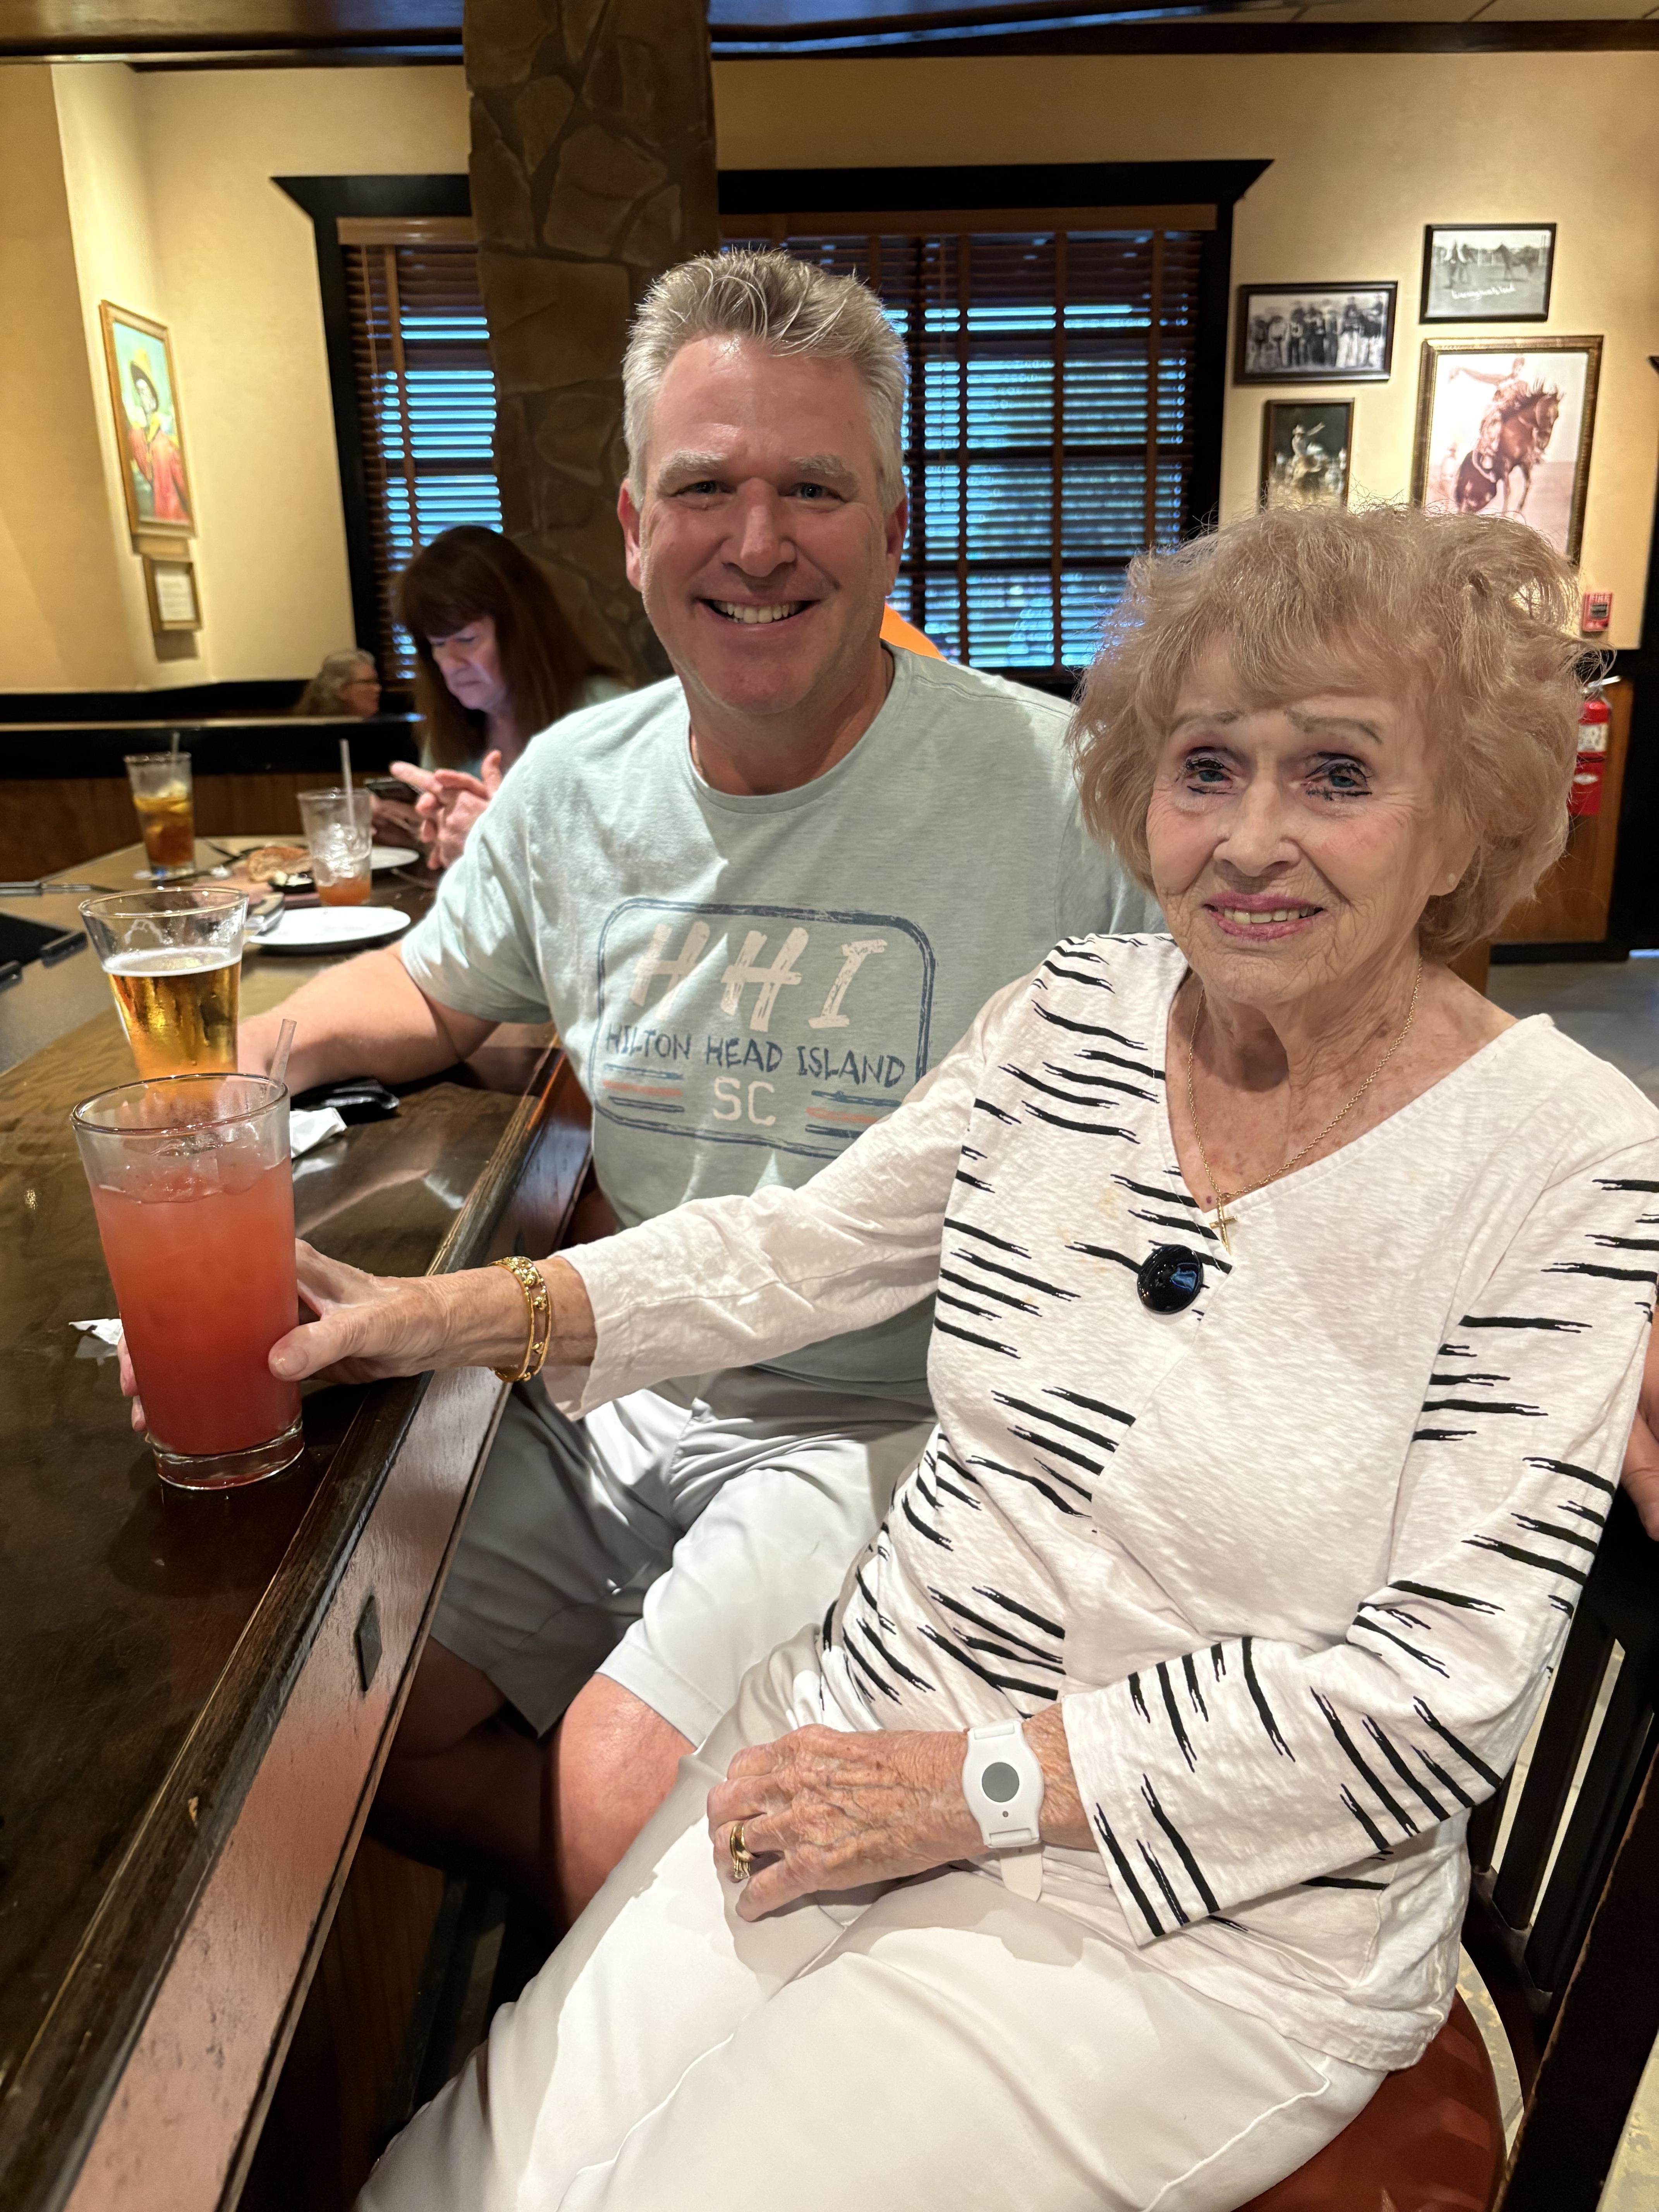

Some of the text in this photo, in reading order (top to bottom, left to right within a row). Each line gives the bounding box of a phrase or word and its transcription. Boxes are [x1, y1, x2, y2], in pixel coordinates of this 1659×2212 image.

[629, 920, 888, 1032] HHI
[605, 1023, 905, 1088] HILTON HEAD ISLAND
[713, 1076, 776, 1126] SC
